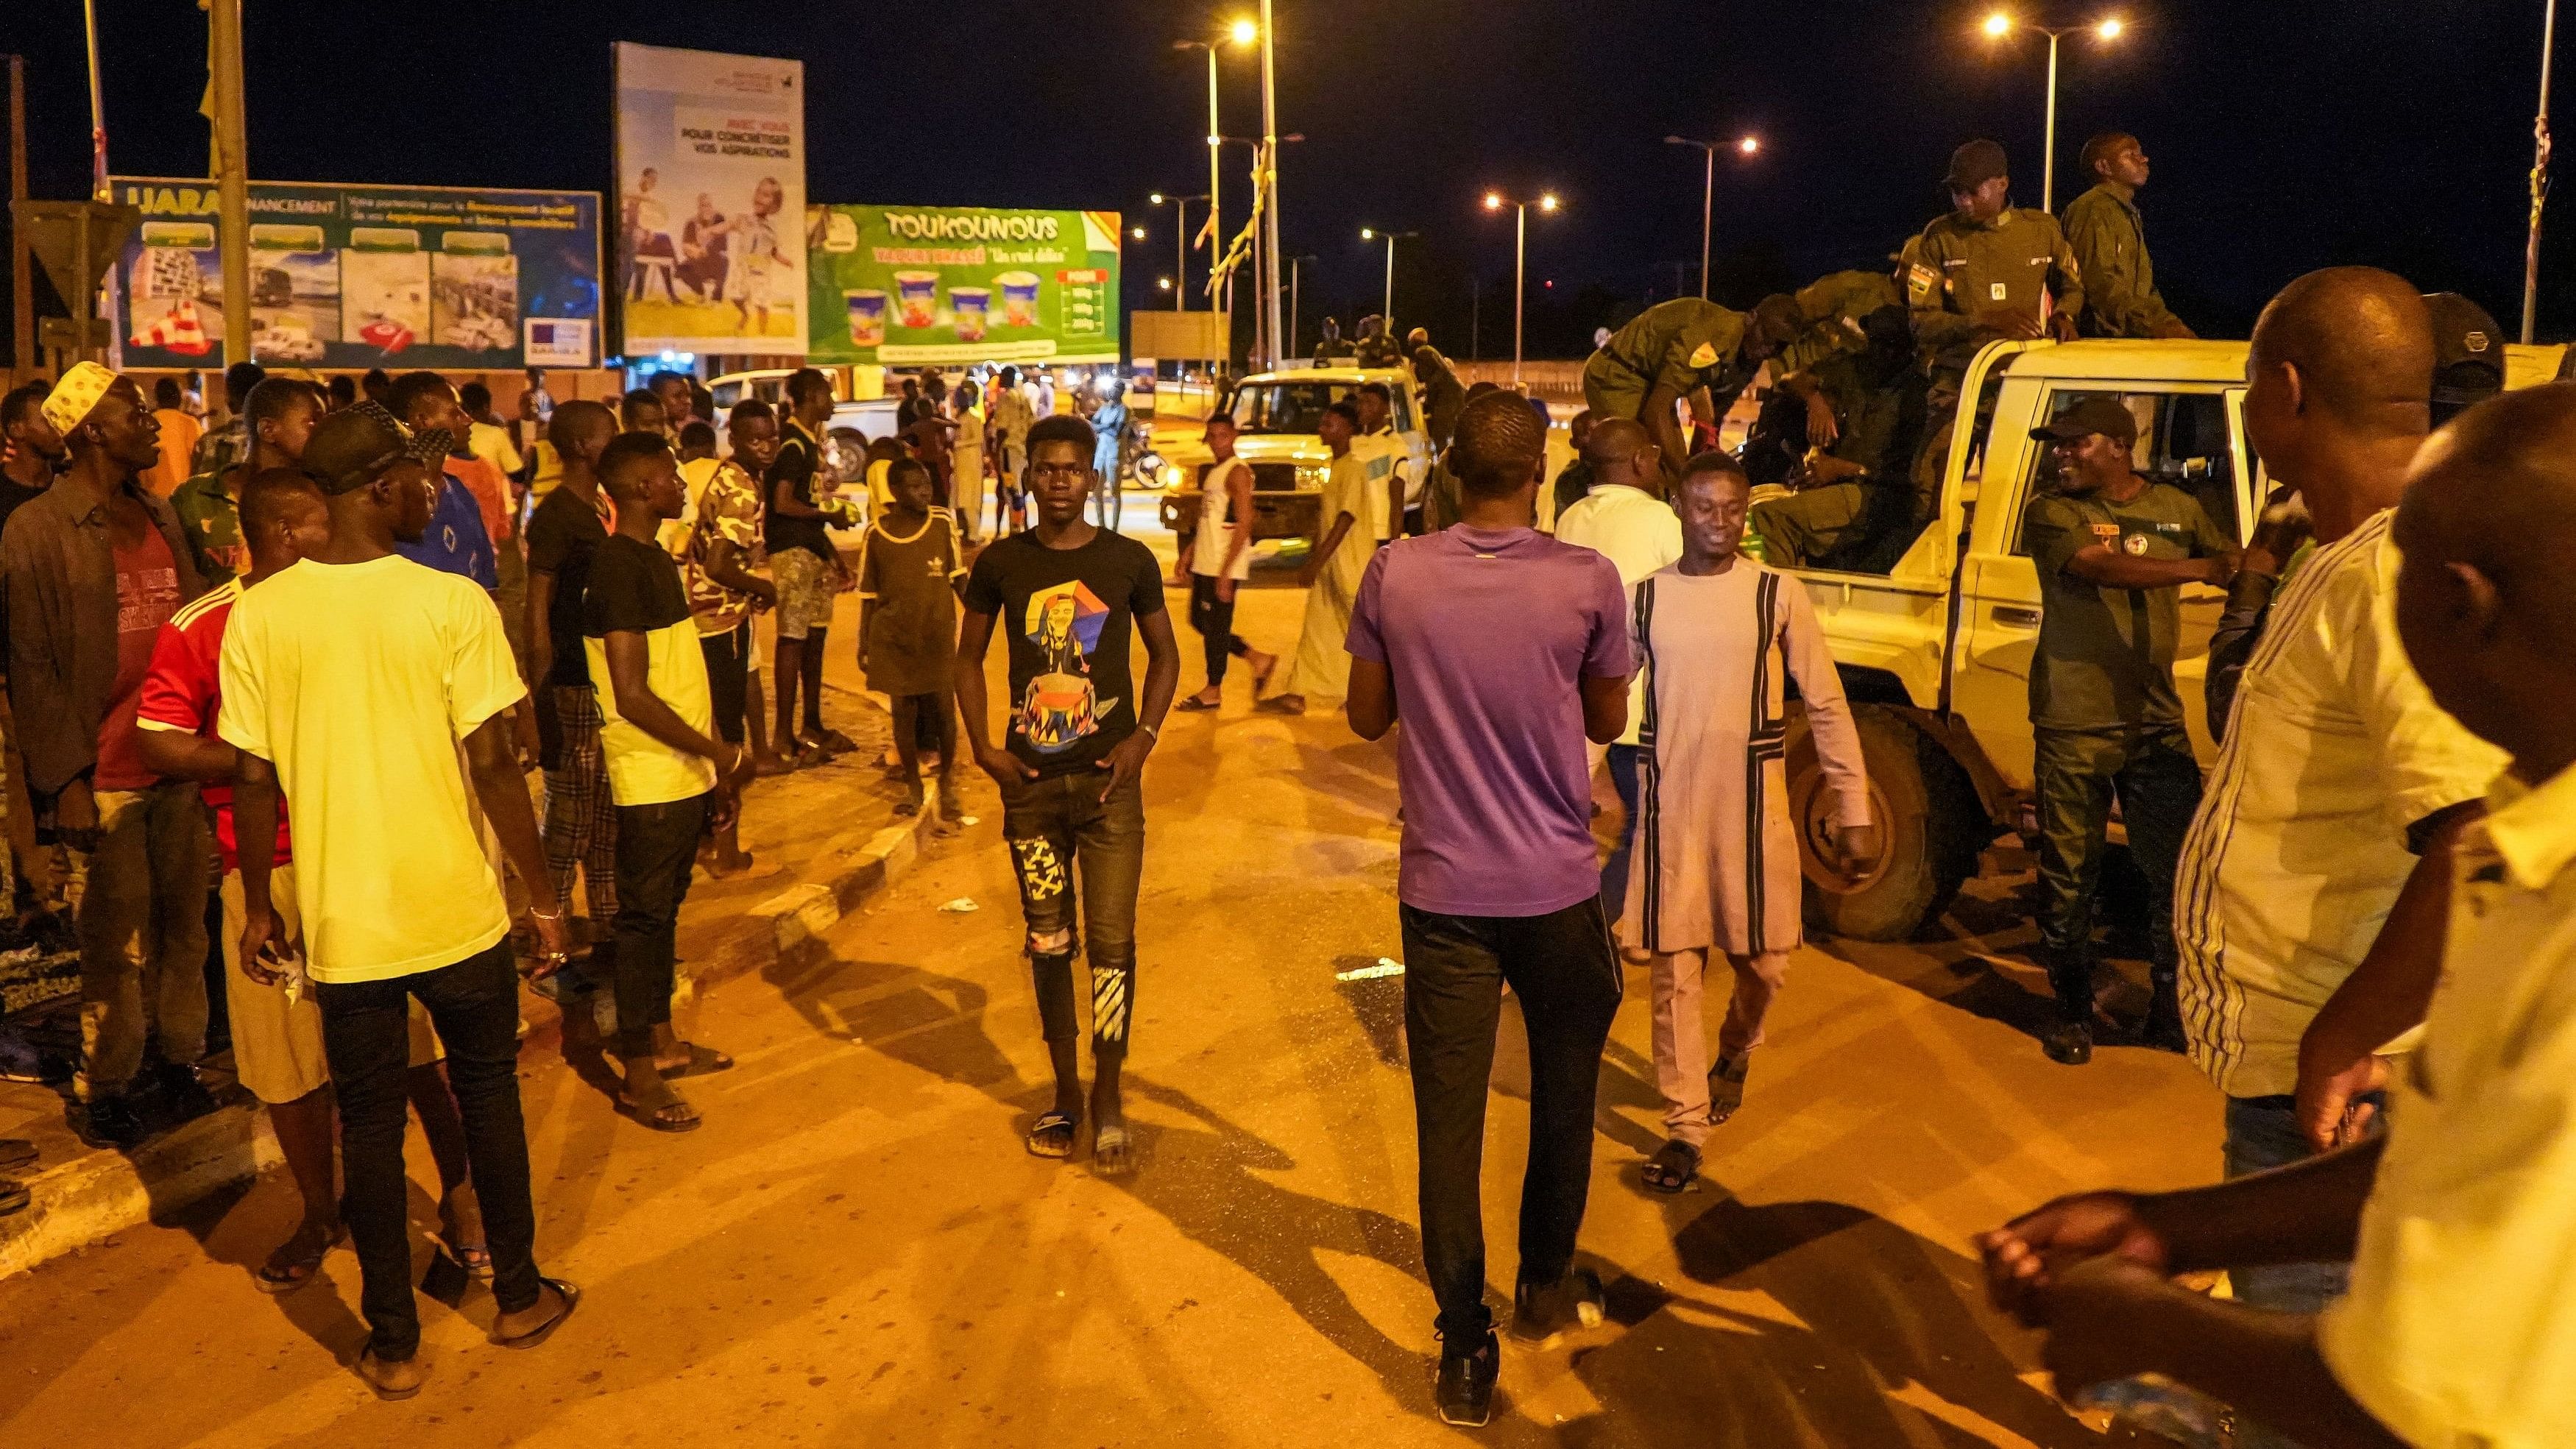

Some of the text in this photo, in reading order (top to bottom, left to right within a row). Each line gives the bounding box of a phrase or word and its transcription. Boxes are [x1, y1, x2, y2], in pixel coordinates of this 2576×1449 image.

[682, 128, 713, 140] POUR
[695, 144, 790, 157] VOS ASPIRATIONS
[245, 199, 336, 214] NANCEMENT
[884, 212, 1059, 241] TOUKOUNOUS
